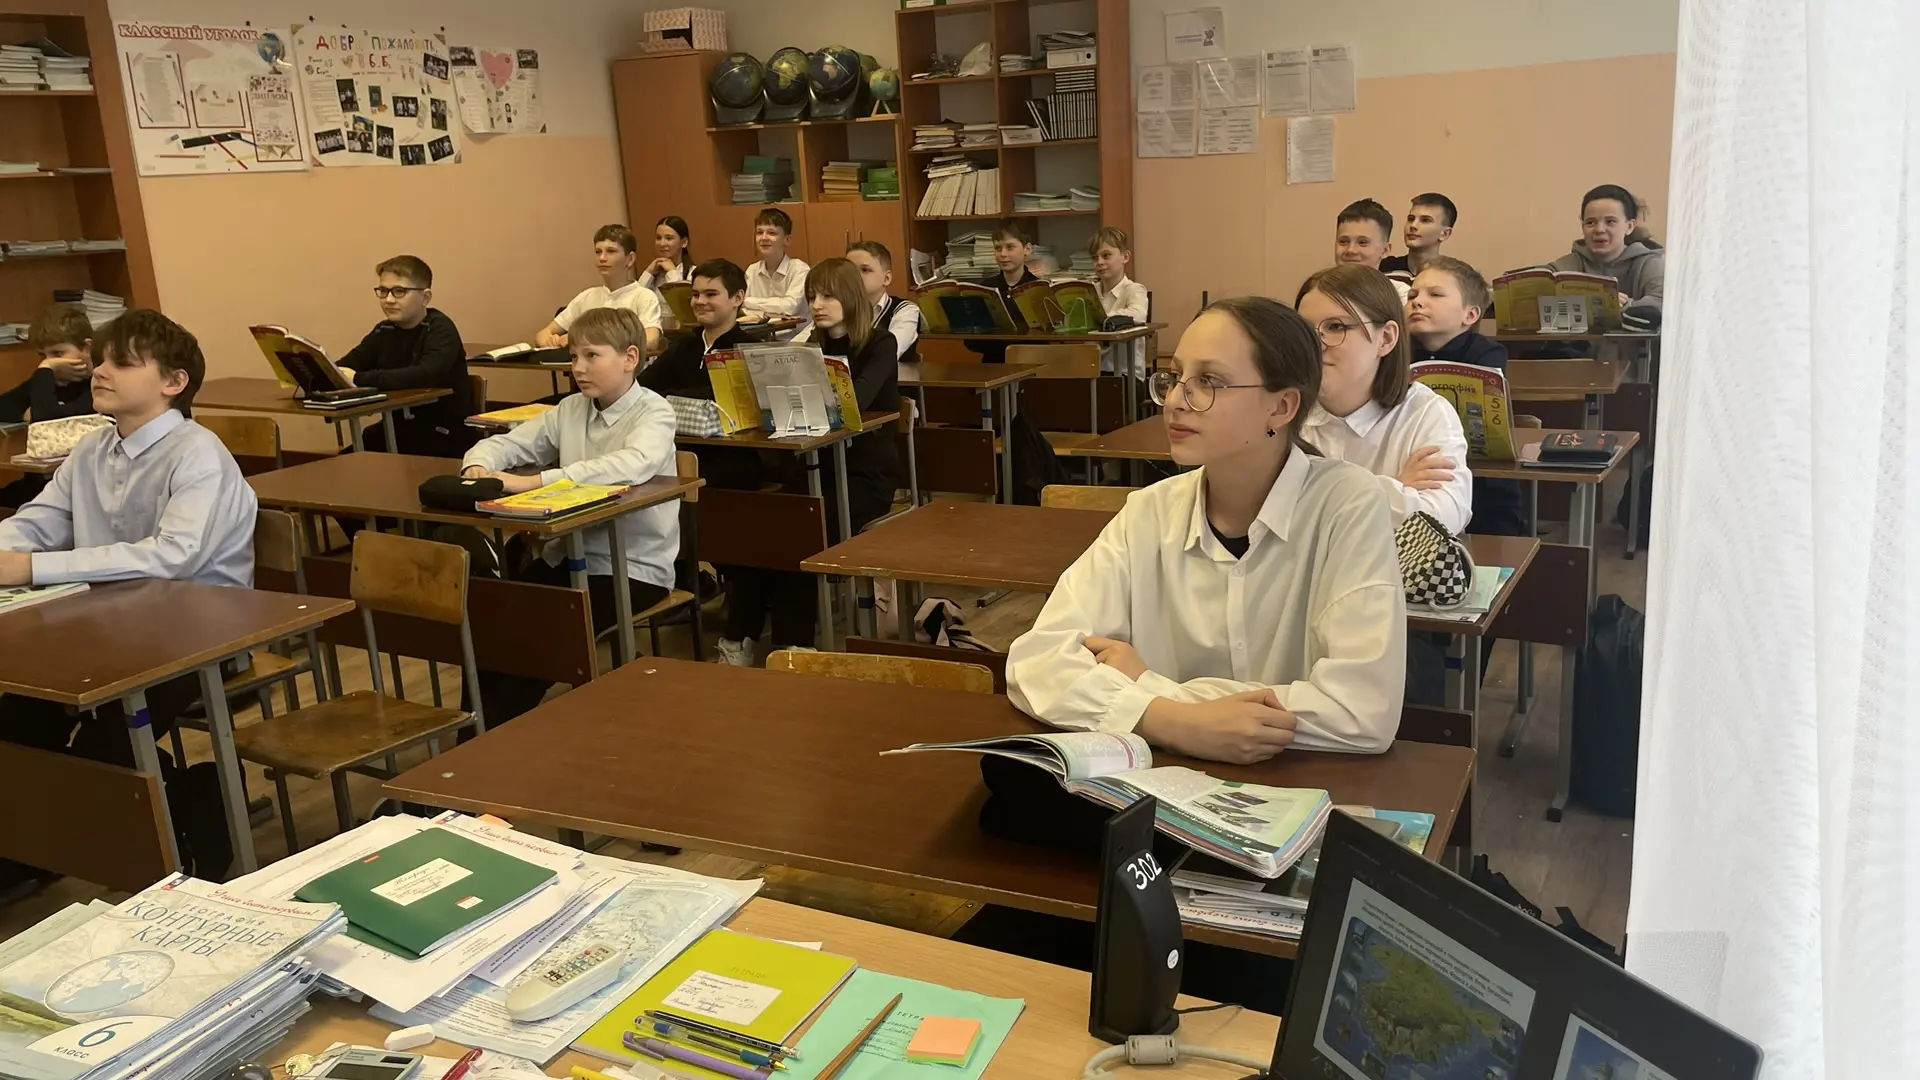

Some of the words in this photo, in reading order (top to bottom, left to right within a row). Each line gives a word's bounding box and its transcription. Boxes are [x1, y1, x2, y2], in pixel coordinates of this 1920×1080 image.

[118, 24, 202, 40] КЛАССНЫЙ
[203, 28, 260, 41] УГОЛОК
[1421, 382, 1477, 394] ография
[1490, 398, 1500, 409] 5
[1491, 415, 1501, 425] 6
[1127, 852, 1162, 890] 302
[125, 900, 284, 947] КОНТУРНЫЕ
[179, 903, 266, 927] ГЕОГРАФИЯ
[131, 925, 228, 957] КАРТЫ
[897, 1011, 924, 1021] ТЕТРА
[78, 1021, 133, 1048] 6
